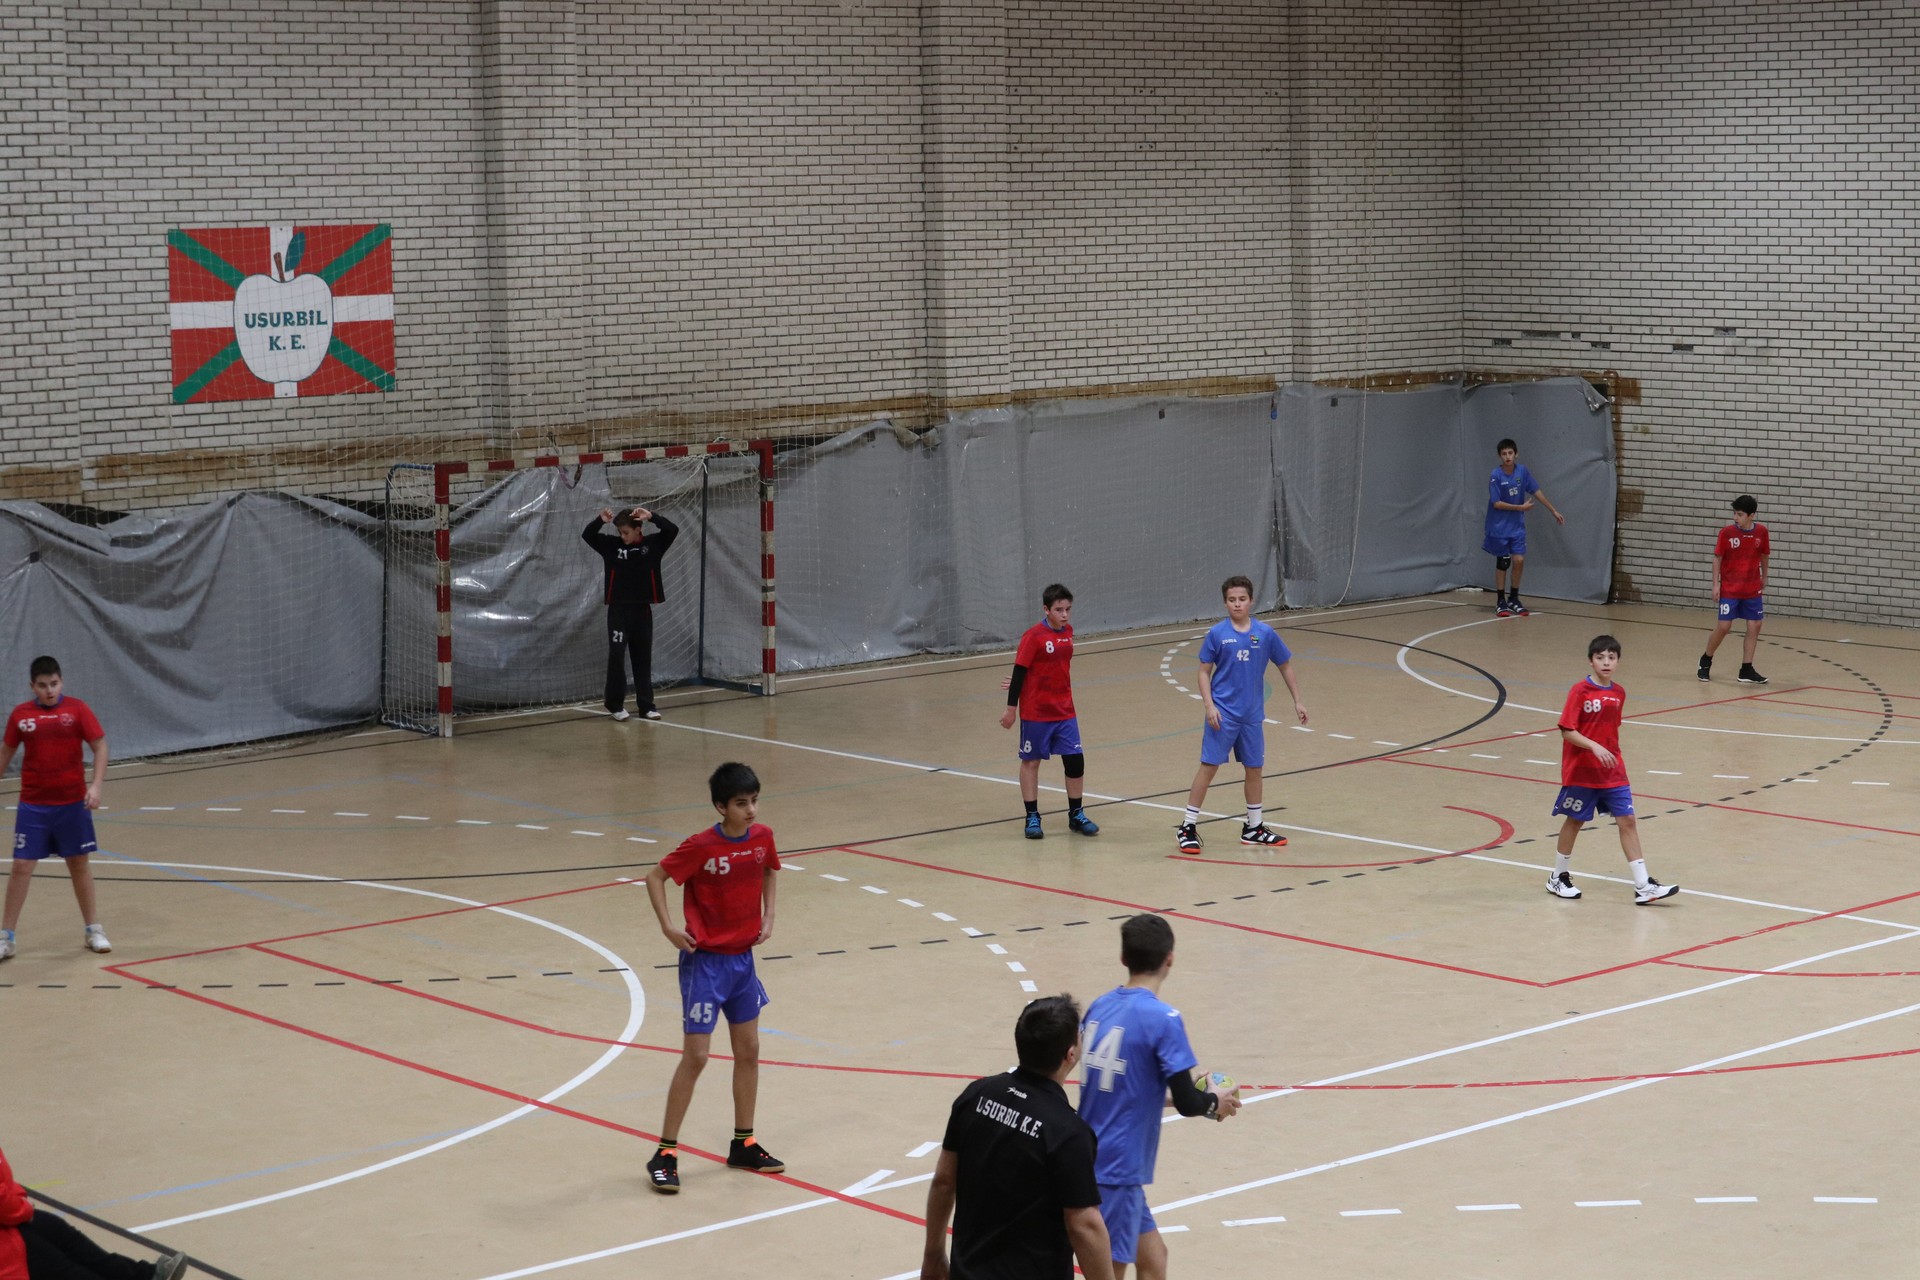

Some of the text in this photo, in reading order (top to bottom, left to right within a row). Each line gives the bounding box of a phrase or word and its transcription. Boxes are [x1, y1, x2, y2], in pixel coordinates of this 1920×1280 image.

[1509, 486, 1519, 497] 65
[1729, 537, 1741, 549] 19
[617, 548, 628, 560] 21
[1720, 603, 1730, 615] 19
[612, 630, 624, 643] 21
[1045, 640, 1055, 654] 8
[1236, 649, 1250, 662] 42
[1583, 698, 1602, 713] 88
[18, 718, 37, 732] 65
[1023, 740, 1033, 753] 8
[1562, 797, 1584, 812] 88
[704, 856, 731, 875] 45
[689, 1002, 713, 1024] 45
